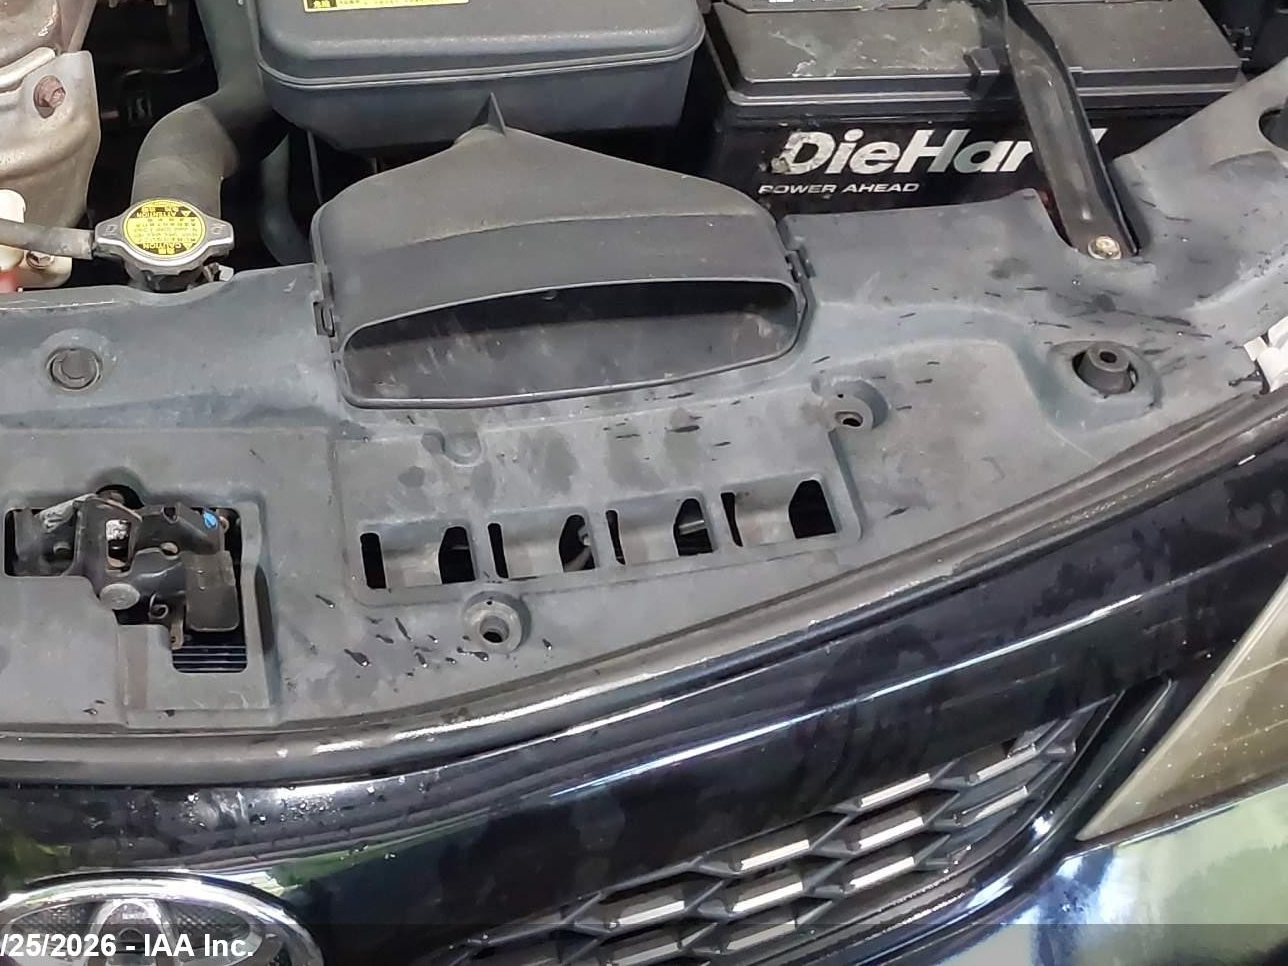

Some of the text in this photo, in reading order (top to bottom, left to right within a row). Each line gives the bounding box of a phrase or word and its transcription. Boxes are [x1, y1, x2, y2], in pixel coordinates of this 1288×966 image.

[771, 128, 1108, 175] DieHar
[758, 183, 920, 195] POWER AHEAD
